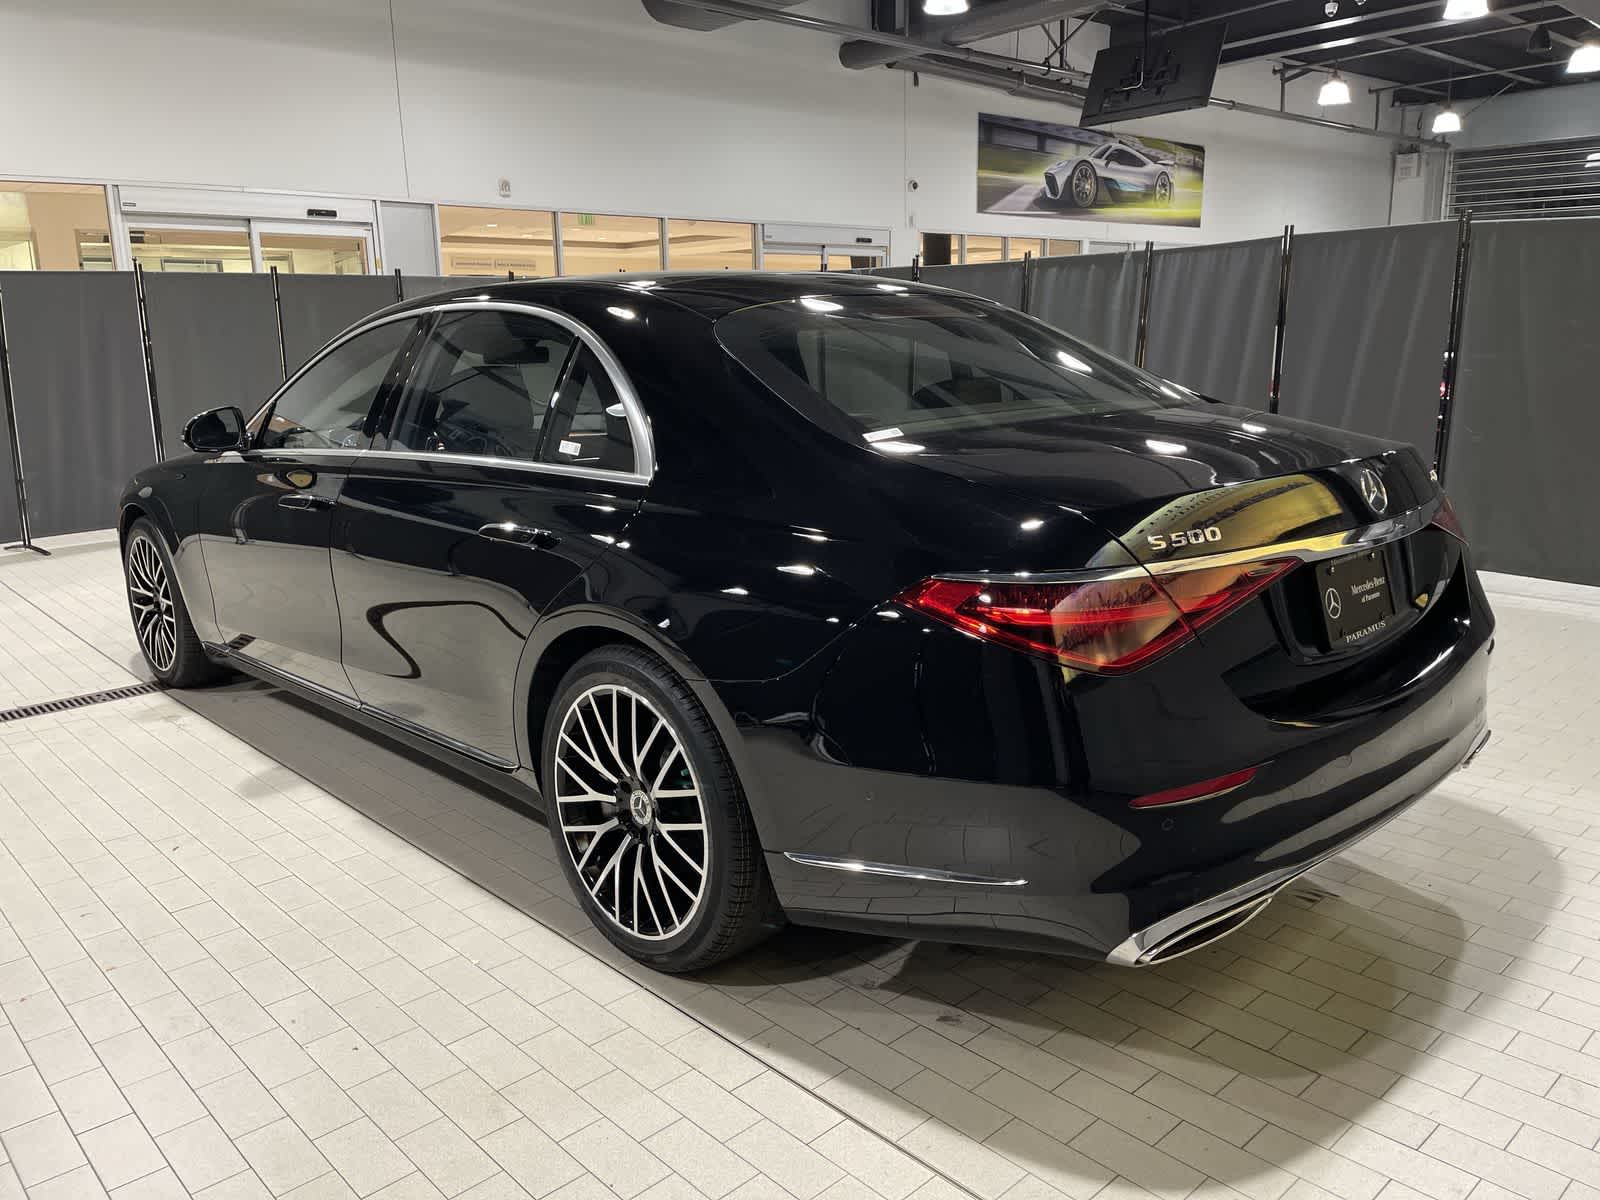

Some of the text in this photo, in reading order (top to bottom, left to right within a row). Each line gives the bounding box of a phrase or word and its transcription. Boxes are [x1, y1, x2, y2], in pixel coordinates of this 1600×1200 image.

[1147, 526, 1222, 550] S 500
[1351, 576, 1385, 595] Mercedes-Benz
[1345, 620, 1386, 643] PARAMUS
